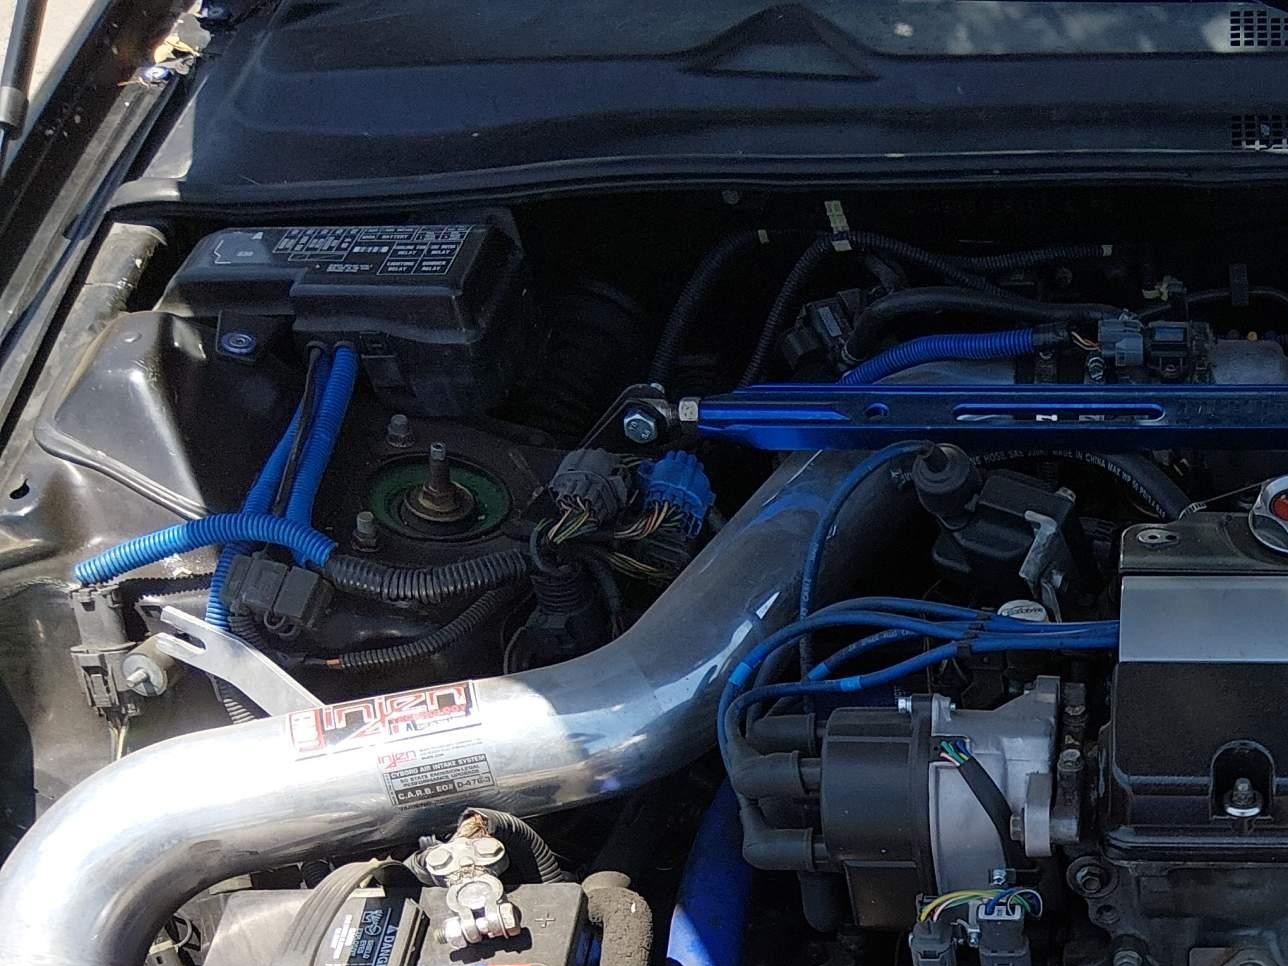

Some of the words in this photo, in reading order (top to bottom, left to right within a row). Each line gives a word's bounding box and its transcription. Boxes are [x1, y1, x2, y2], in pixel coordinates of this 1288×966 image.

[1085, 454, 1106, 468] CHINA
[432, 761, 457, 771] INTAKE
[457, 754, 486, 765] SYSTEM
